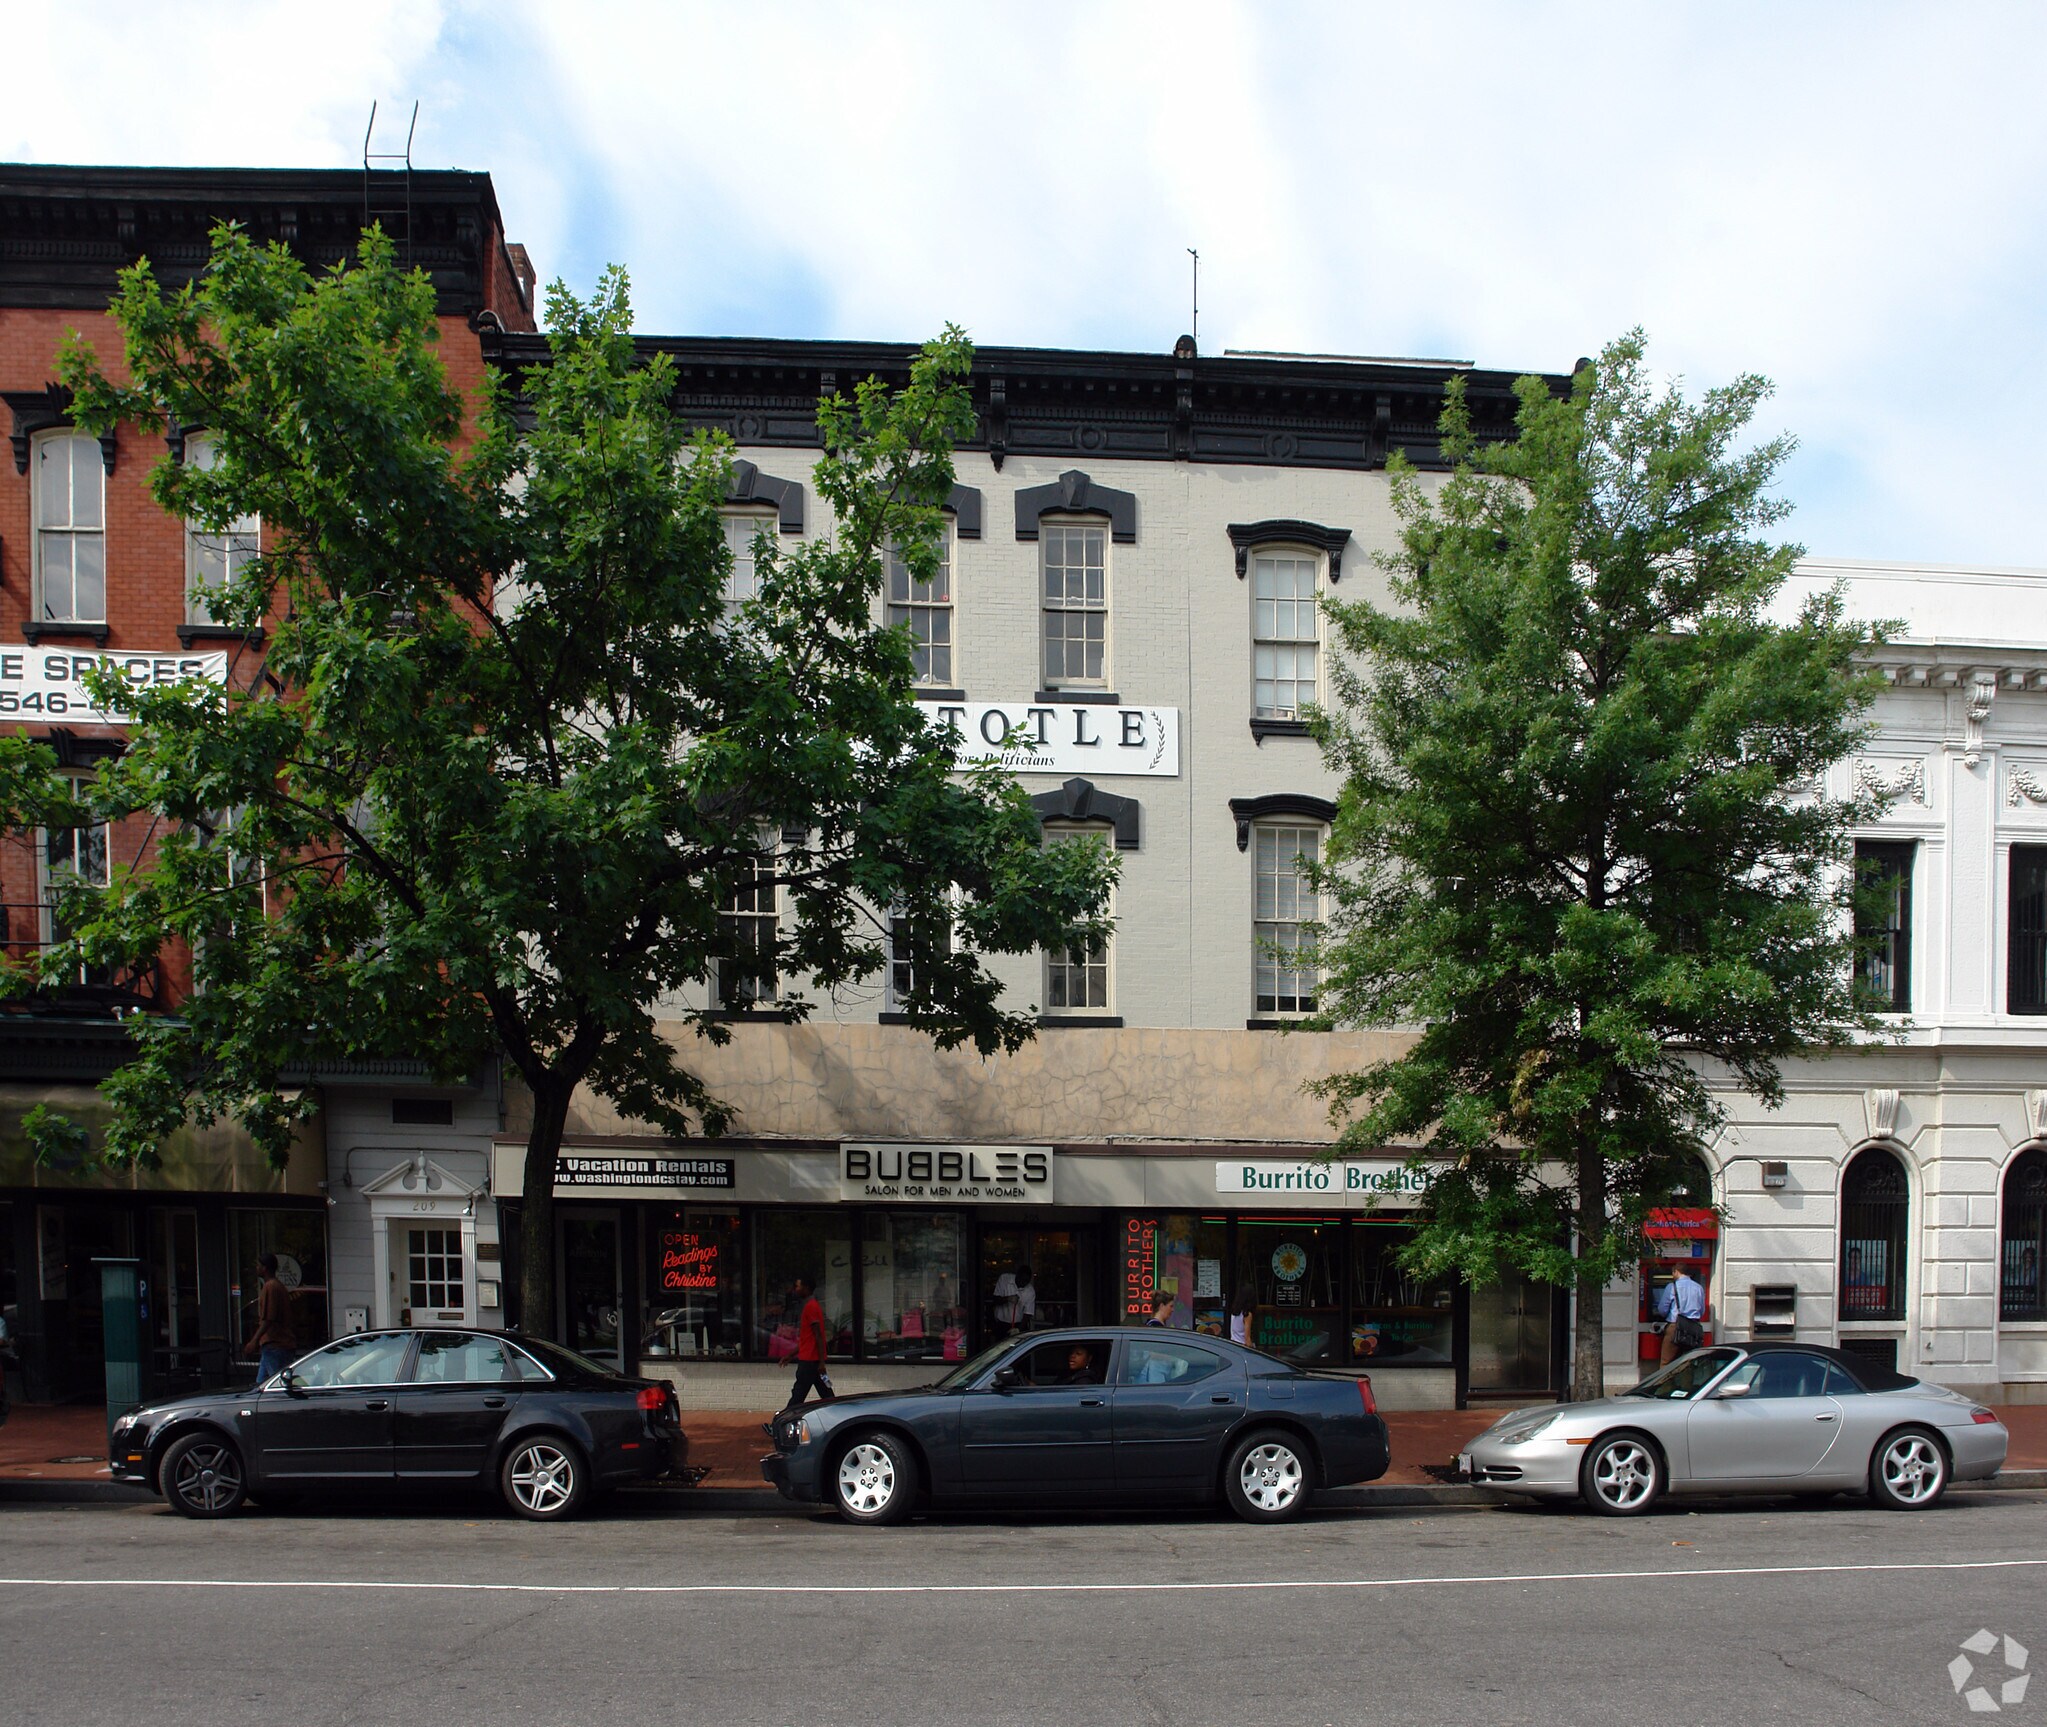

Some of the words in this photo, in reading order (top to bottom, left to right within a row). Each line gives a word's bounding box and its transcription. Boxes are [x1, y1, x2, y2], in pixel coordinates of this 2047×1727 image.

[937, 706, 1146, 747] TOTLE
[984, 752, 1056, 767] Pliticians
[566, 1159, 649, 1172] Vacation
[655, 1160, 727, 1173] Rentals
[846, 1149, 1048, 1183] BUBBLES
[553, 1173, 728, 1187] w.washingtondcstay.com
[1242, 1165, 1330, 1190] Burrito
[1346, 1166, 1434, 1191] Brother
[864, 1184, 899, 1196] SALON
[904, 1185, 924, 1196] FOR
[929, 1186, 951, 1197] MEN
[957, 1187, 980, 1198] AND
[985, 1187, 1026, 1198] WOMEN
[412, 1200, 436, 1212] 209
[664, 1233, 699, 1246] OPEN
[662, 1245, 719, 1269] Readings
[699, 1263, 713, 1274] BY
[1127, 1218, 1141, 1314] BURRITO
[1141, 1218, 1158, 1314] BROTHERS
[663, 1271, 717, 1288] Christine
[1264, 1315, 1313, 1330] Burrito
[1259, 1331, 1320, 1345] Brothers
